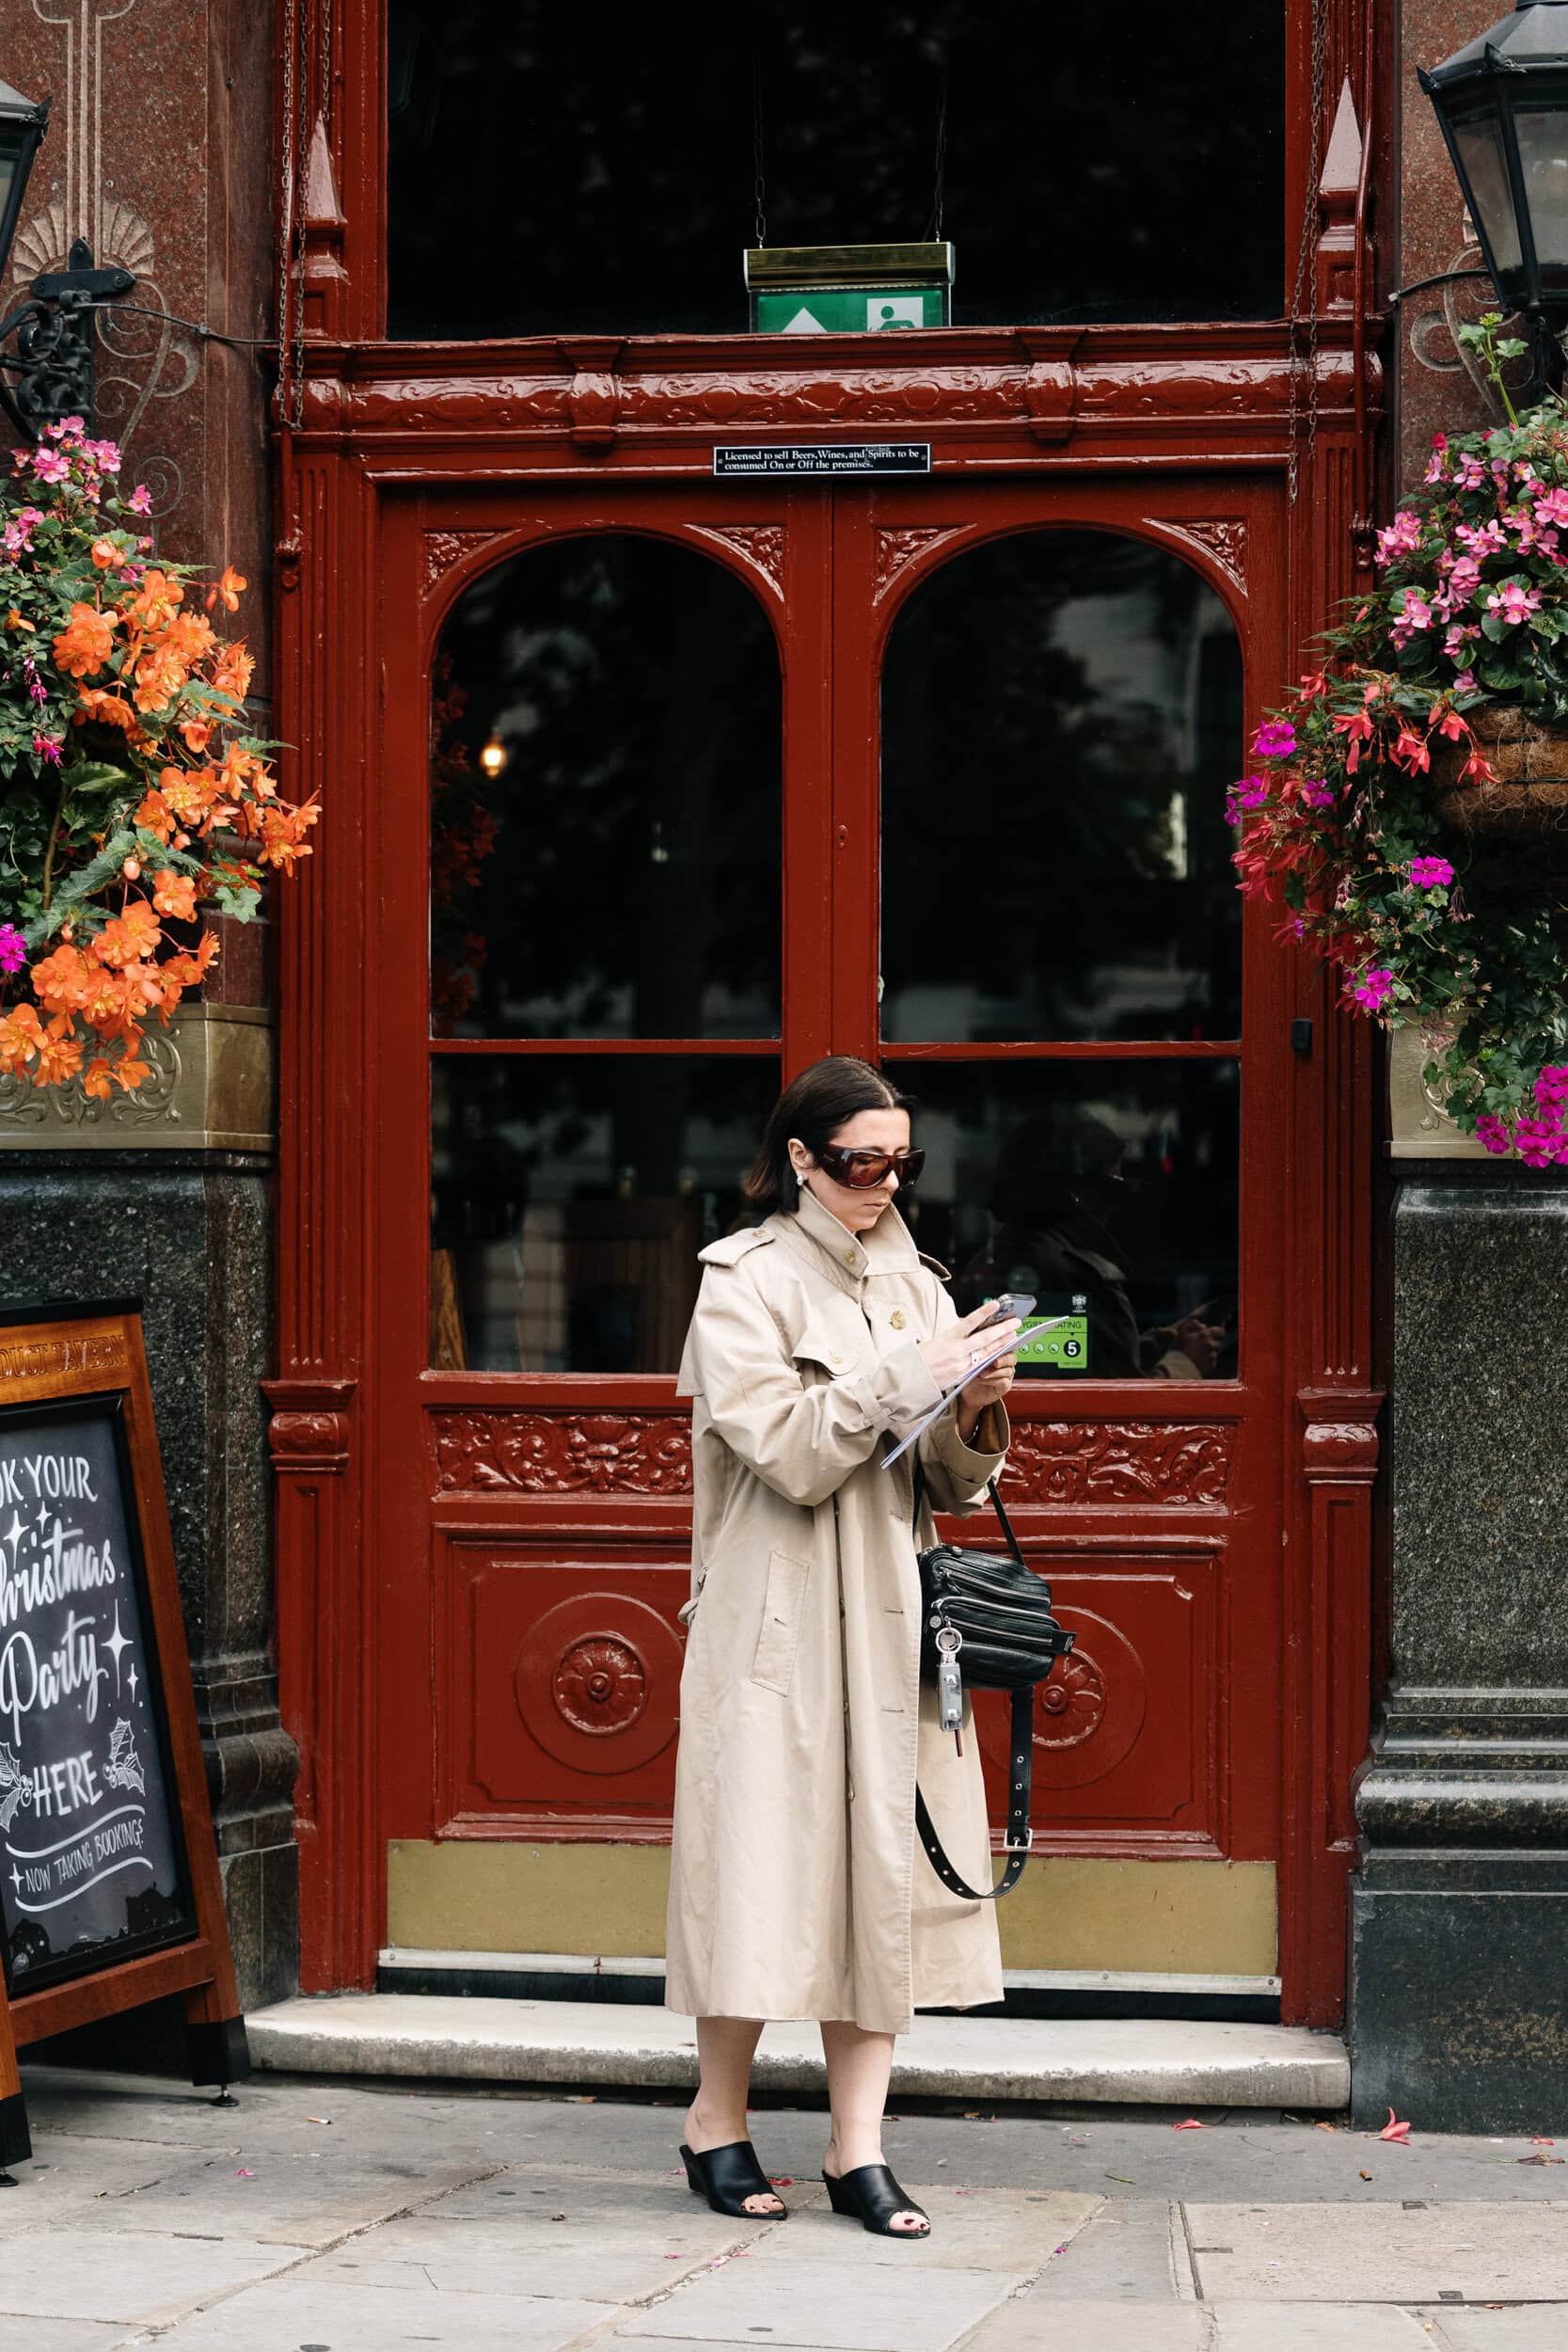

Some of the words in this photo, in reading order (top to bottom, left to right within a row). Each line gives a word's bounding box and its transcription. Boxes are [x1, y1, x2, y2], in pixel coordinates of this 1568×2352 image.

[724, 451, 762, 460] Licensed
[774, 451, 789, 460] sell
[792, 450, 818, 460] Beers,
[817, 450, 848, 460] Wines,
[848, 449, 865, 459] and
[867, 450, 895, 460] Spirits
[909, 448, 919, 458] be
[724, 460, 768, 470] consumed
[769, 460, 784, 469] On
[798, 459, 815, 469] Off
[815, 459, 830, 469] the
[832, 460, 874, 470] premises.
[51, 1334, 128, 1373] TAVERN
[1068, 1342, 1077, 1356] 5
[0, 1458, 24, 1506] K
[24, 1454, 98, 1502] YOUR
[0, 1610, 110, 1747] Party
[33, 1750, 103, 1818] HERE
[25, 1864, 51, 1893] NOW
[53, 1841, 95, 1884] TAKING
